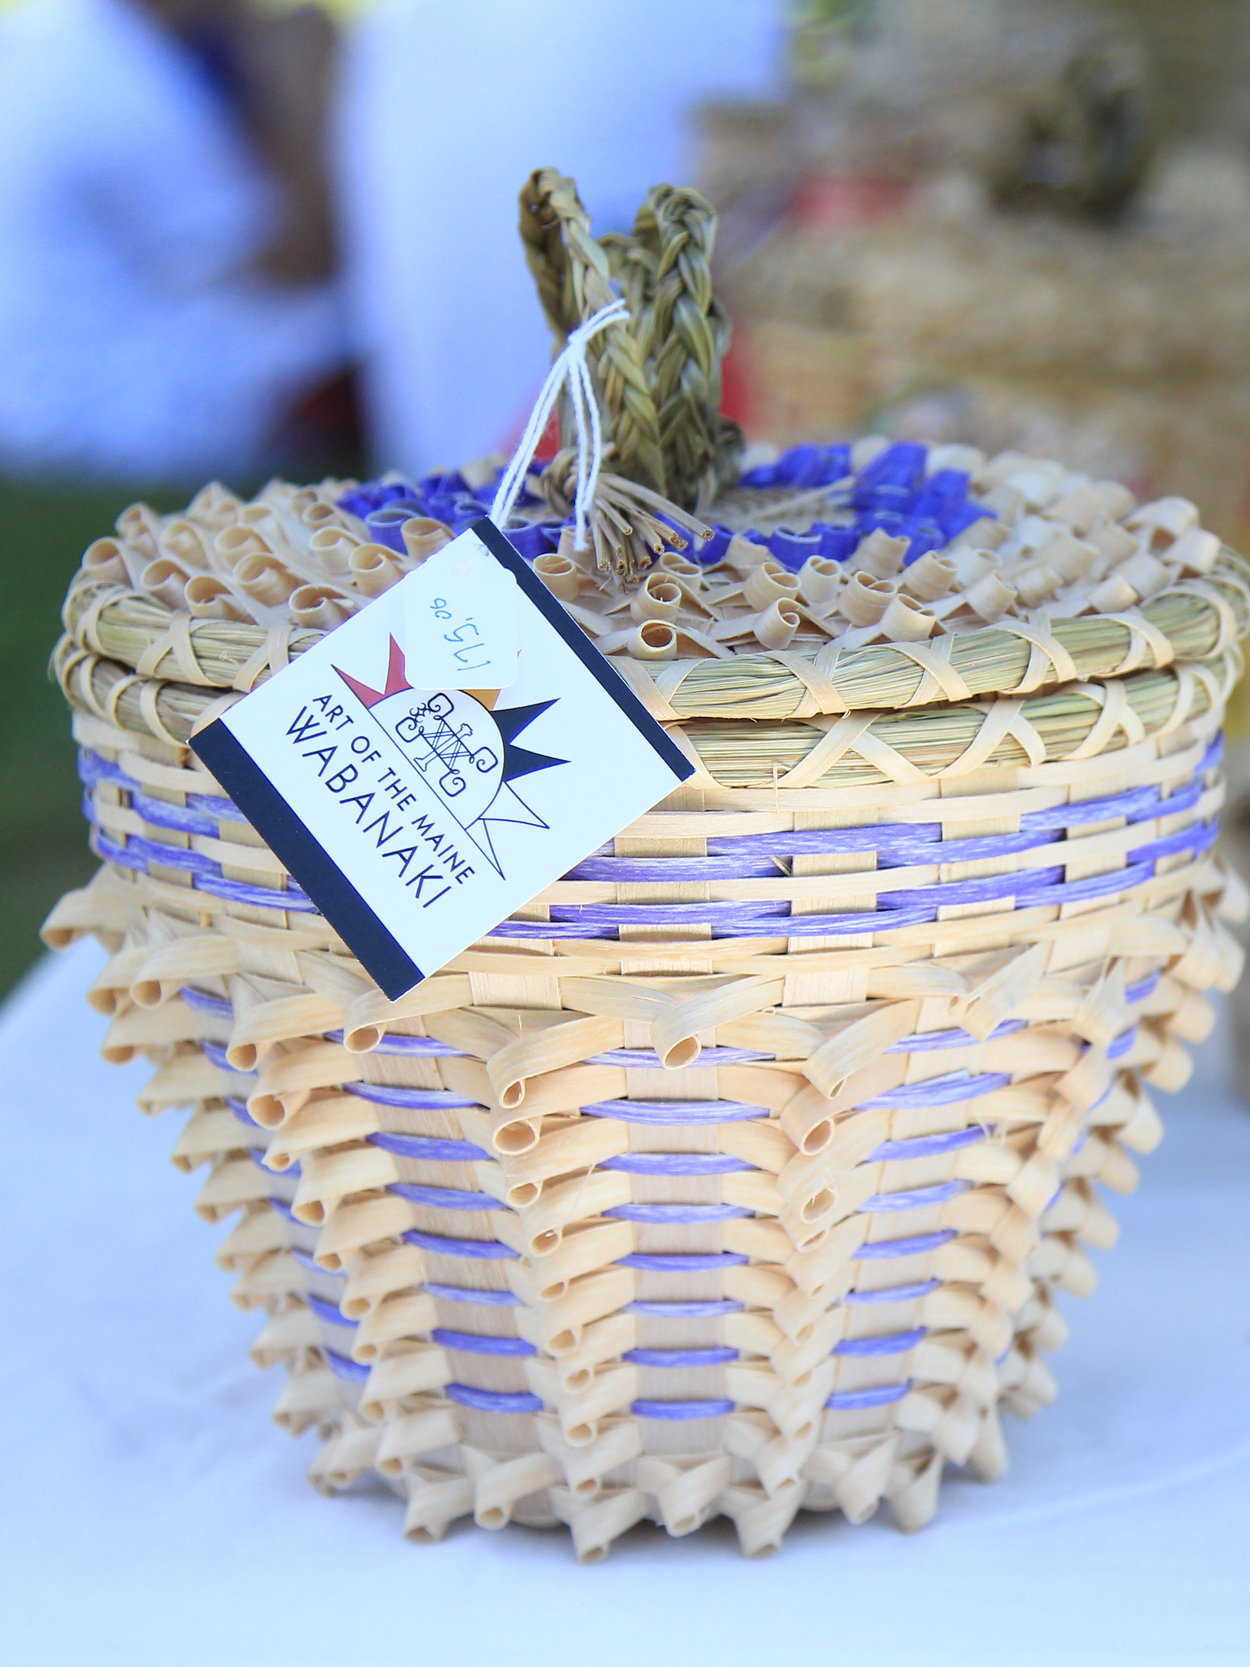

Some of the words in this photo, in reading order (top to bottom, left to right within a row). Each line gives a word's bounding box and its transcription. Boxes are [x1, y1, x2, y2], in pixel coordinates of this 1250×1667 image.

[285, 705, 452, 908] WABANAKI
[312, 694, 354, 730] ART
[350, 735, 382, 763] OF
[377, 767, 417, 812] THE
[411, 814, 475, 885] MAINE
